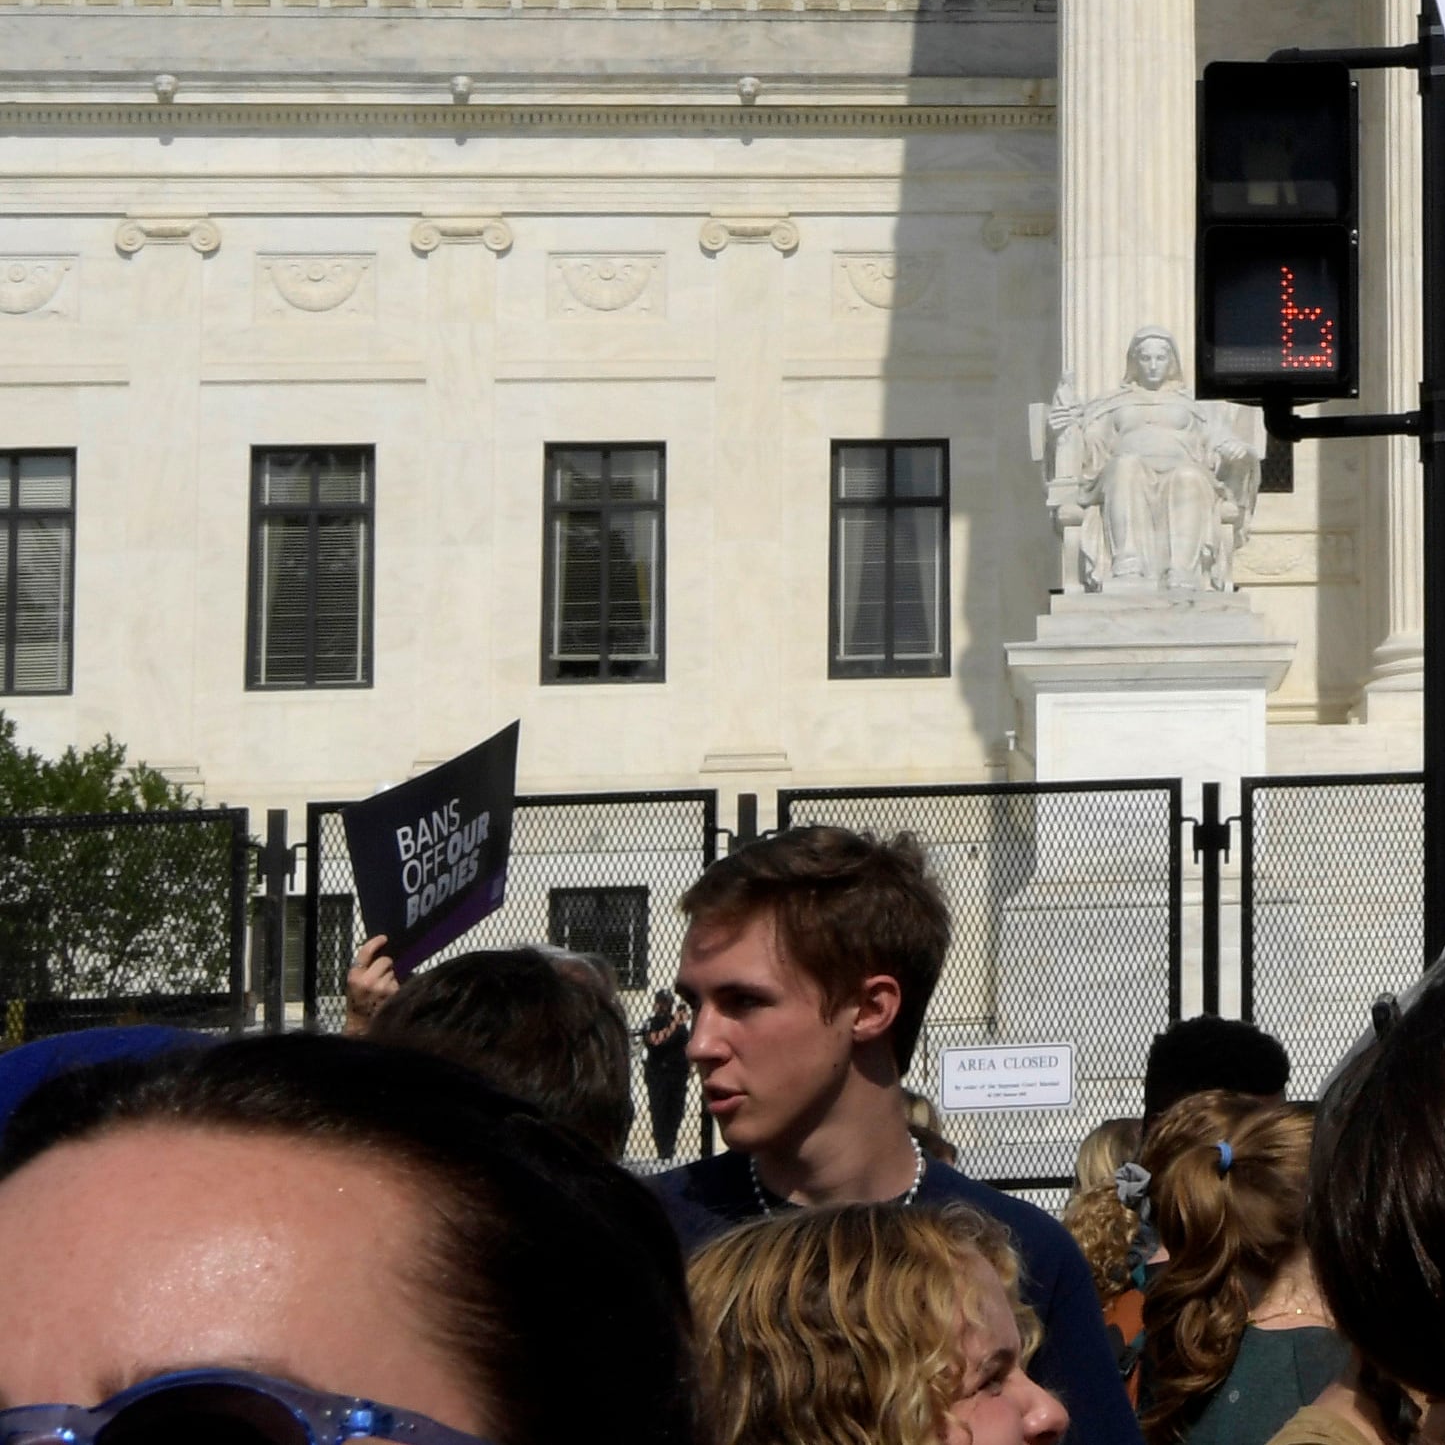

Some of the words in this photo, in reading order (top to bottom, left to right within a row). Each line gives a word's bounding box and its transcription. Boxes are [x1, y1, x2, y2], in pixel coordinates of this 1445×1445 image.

[396, 797, 460, 861] BANS
[402, 841, 445, 894] OFF
[447, 811, 490, 865] OUR
[406, 847, 480, 929] BODIES
[957, 1057, 997, 1072] AREA
[1003, 1055, 1059, 1070] CLOSED
